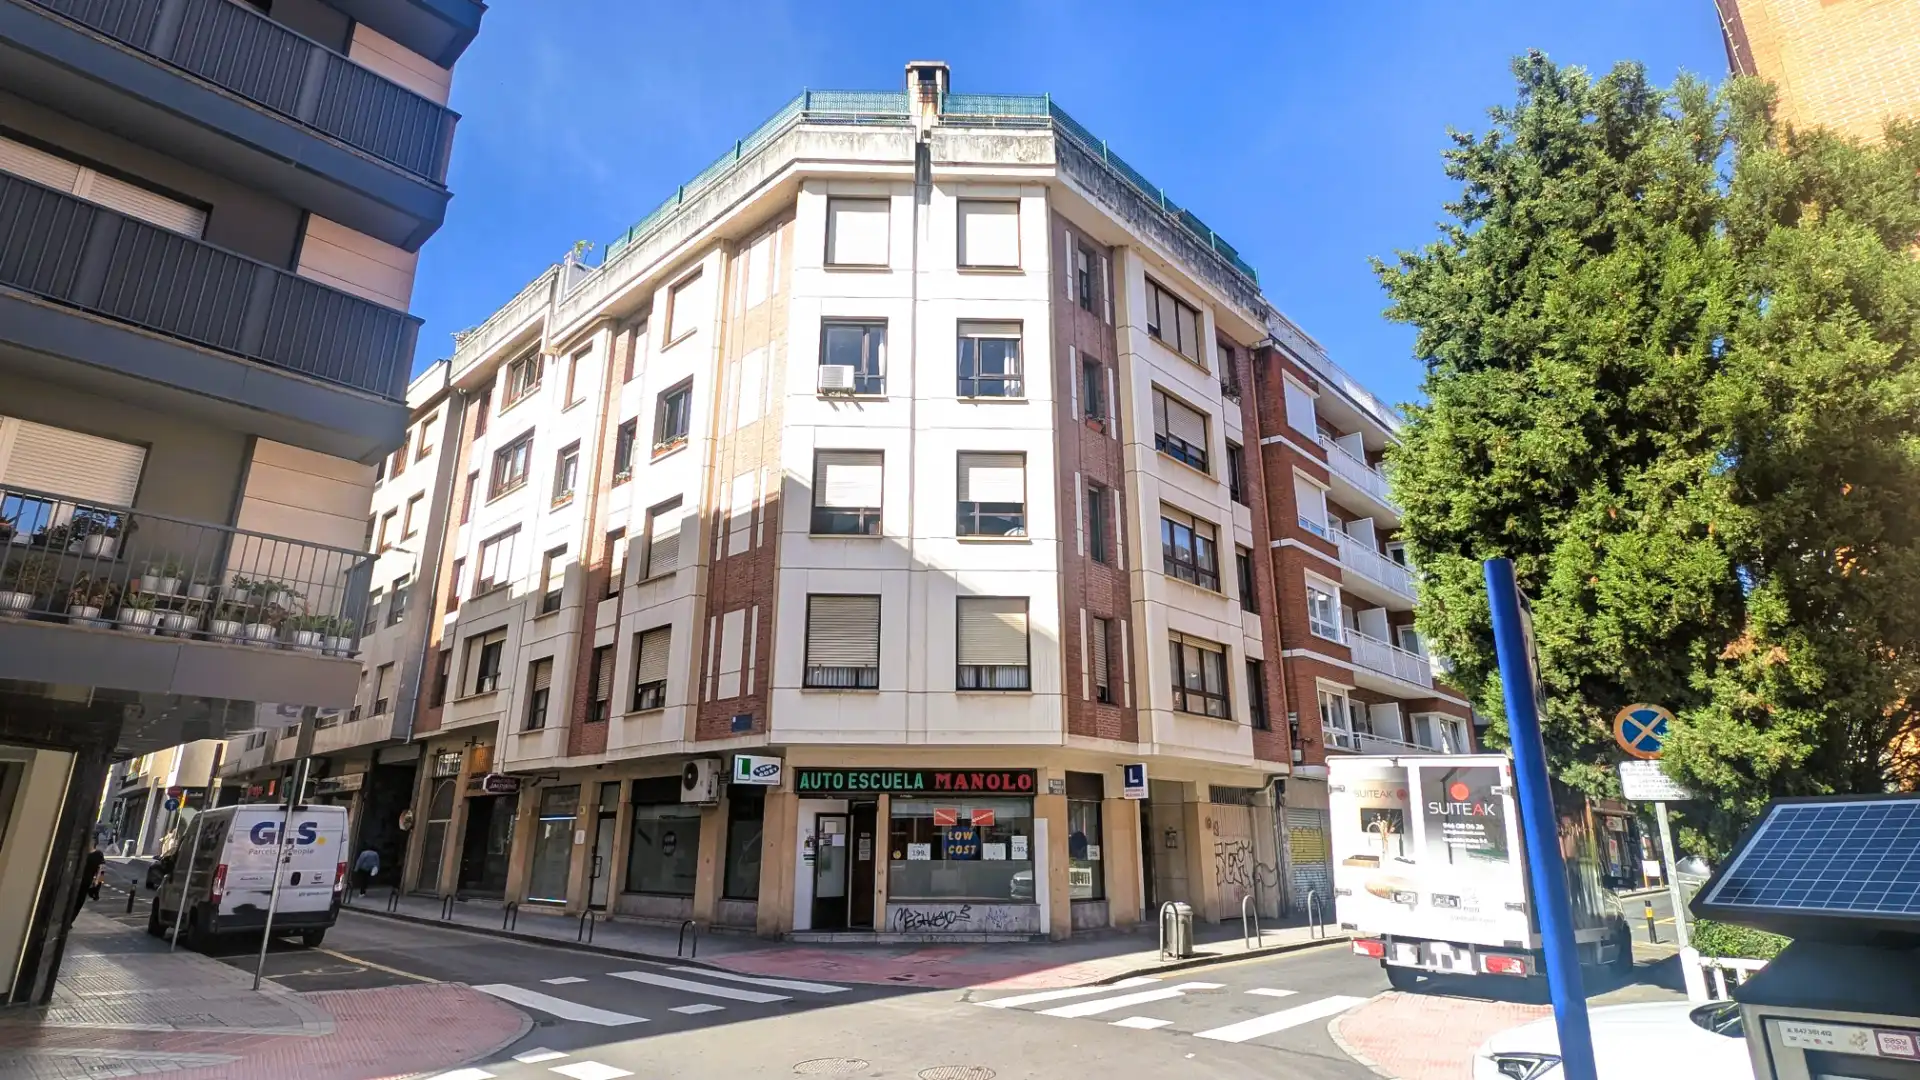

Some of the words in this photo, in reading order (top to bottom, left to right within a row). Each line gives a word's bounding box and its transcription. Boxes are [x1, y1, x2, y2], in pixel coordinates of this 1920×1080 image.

[799, 772, 844, 790] AUTO
[848, 772, 924, 790] ESCUELA
[934, 772, 1032, 791] MANOLO
[1129, 768, 1139, 784] L
[1428, 801, 1496, 816] SUITEAK
[250, 821, 318, 846] GLS
[948, 831, 974, 841] LOW
[948, 845, 977, 855] COST
